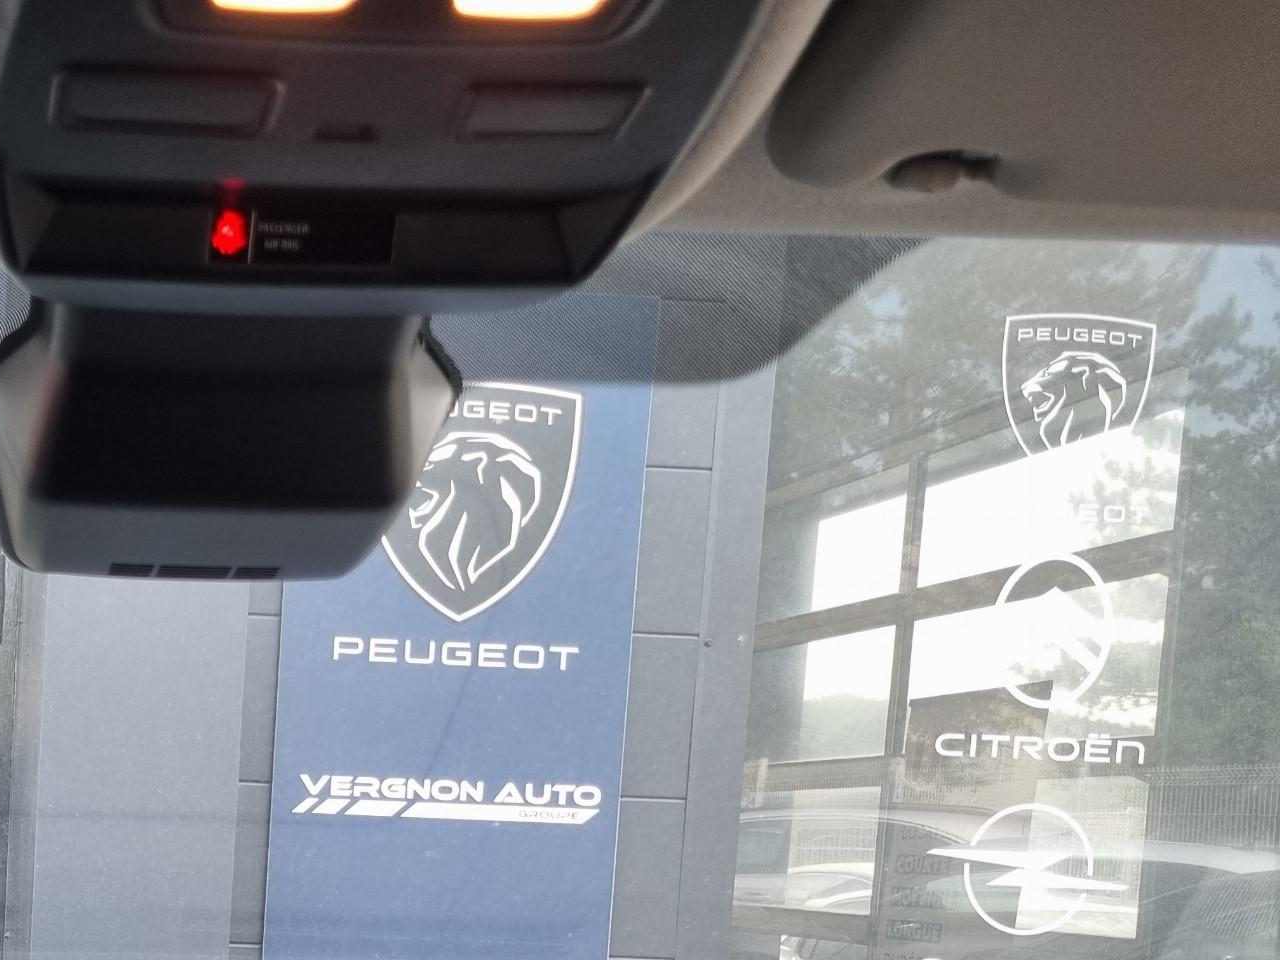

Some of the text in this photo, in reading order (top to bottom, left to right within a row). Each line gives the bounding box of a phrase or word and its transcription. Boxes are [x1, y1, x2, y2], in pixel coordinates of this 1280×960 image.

[1017, 327, 1143, 348] PEUGEOT
[448, 399, 562, 426] GEOT
[332, 636, 579, 671] PEUGEOT
[299, 773, 602, 806] VERGNON AUTO
[519, 811, 579, 820] GROUPE
